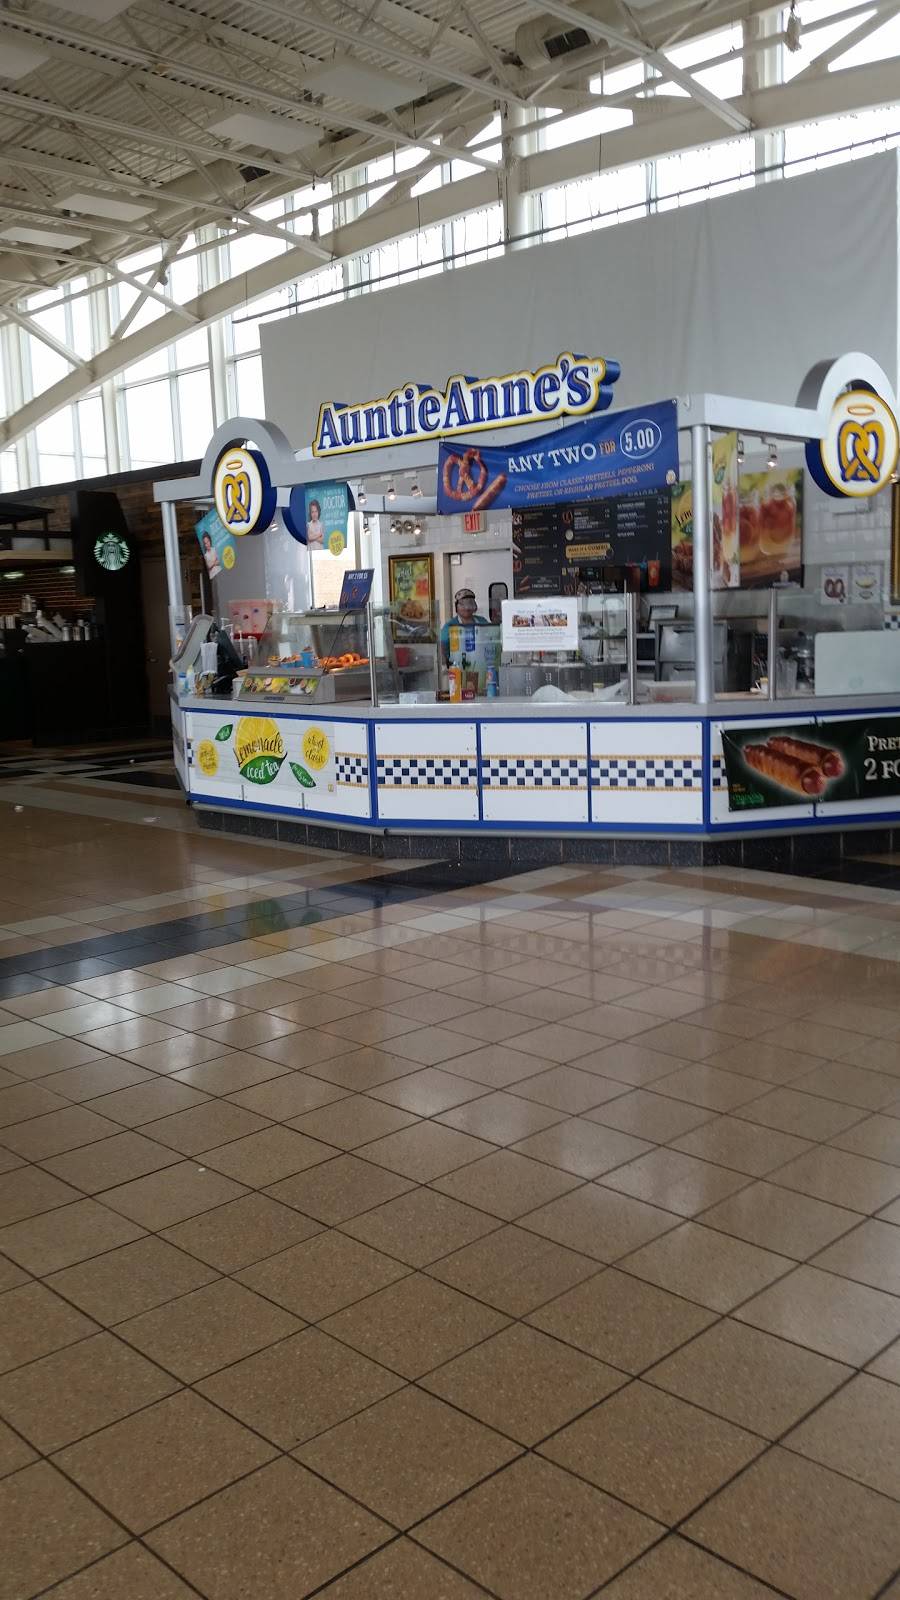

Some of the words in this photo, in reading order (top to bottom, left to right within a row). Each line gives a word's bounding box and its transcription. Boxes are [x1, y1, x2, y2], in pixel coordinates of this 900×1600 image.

[507, 452, 545, 473] ANY
[548, 443, 597, 467] TWO
[599, 440, 616, 455] FOR
[624, 427, 655, 451] 5.00
[464, 512, 480, 532] EXIT
[233, 732, 284, 767] Lemonade
[265, 759, 280, 776] tea
[863, 757, 877, 780] 2
